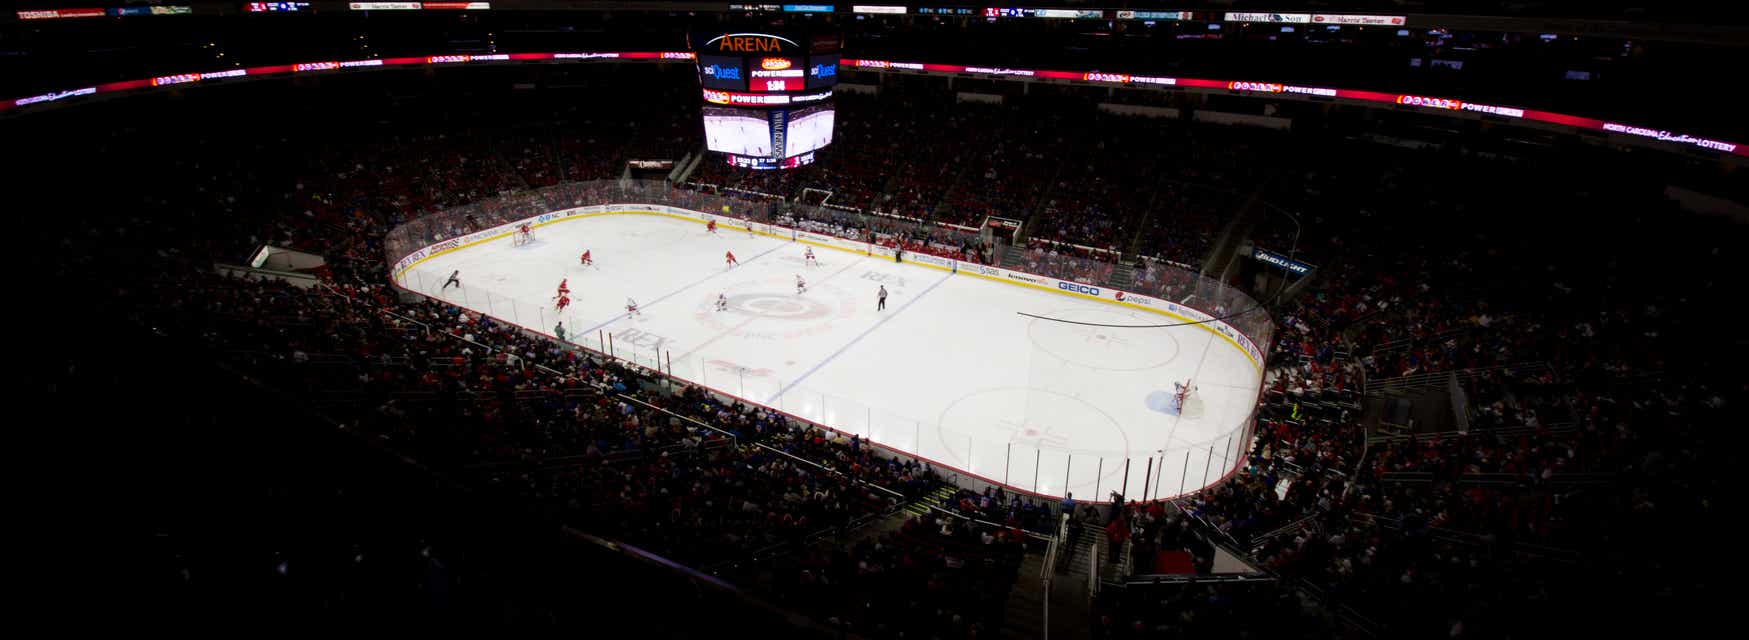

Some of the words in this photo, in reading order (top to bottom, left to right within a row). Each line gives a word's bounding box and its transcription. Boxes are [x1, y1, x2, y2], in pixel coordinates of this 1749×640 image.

[18, 11, 60, 19] TOSHIBA
[720, 33, 781, 52] ARENA
[1697, 139, 1737, 152] LOTTERY
[1058, 281, 1099, 296] GEICO
[1127, 295, 1152, 305] pepsi
